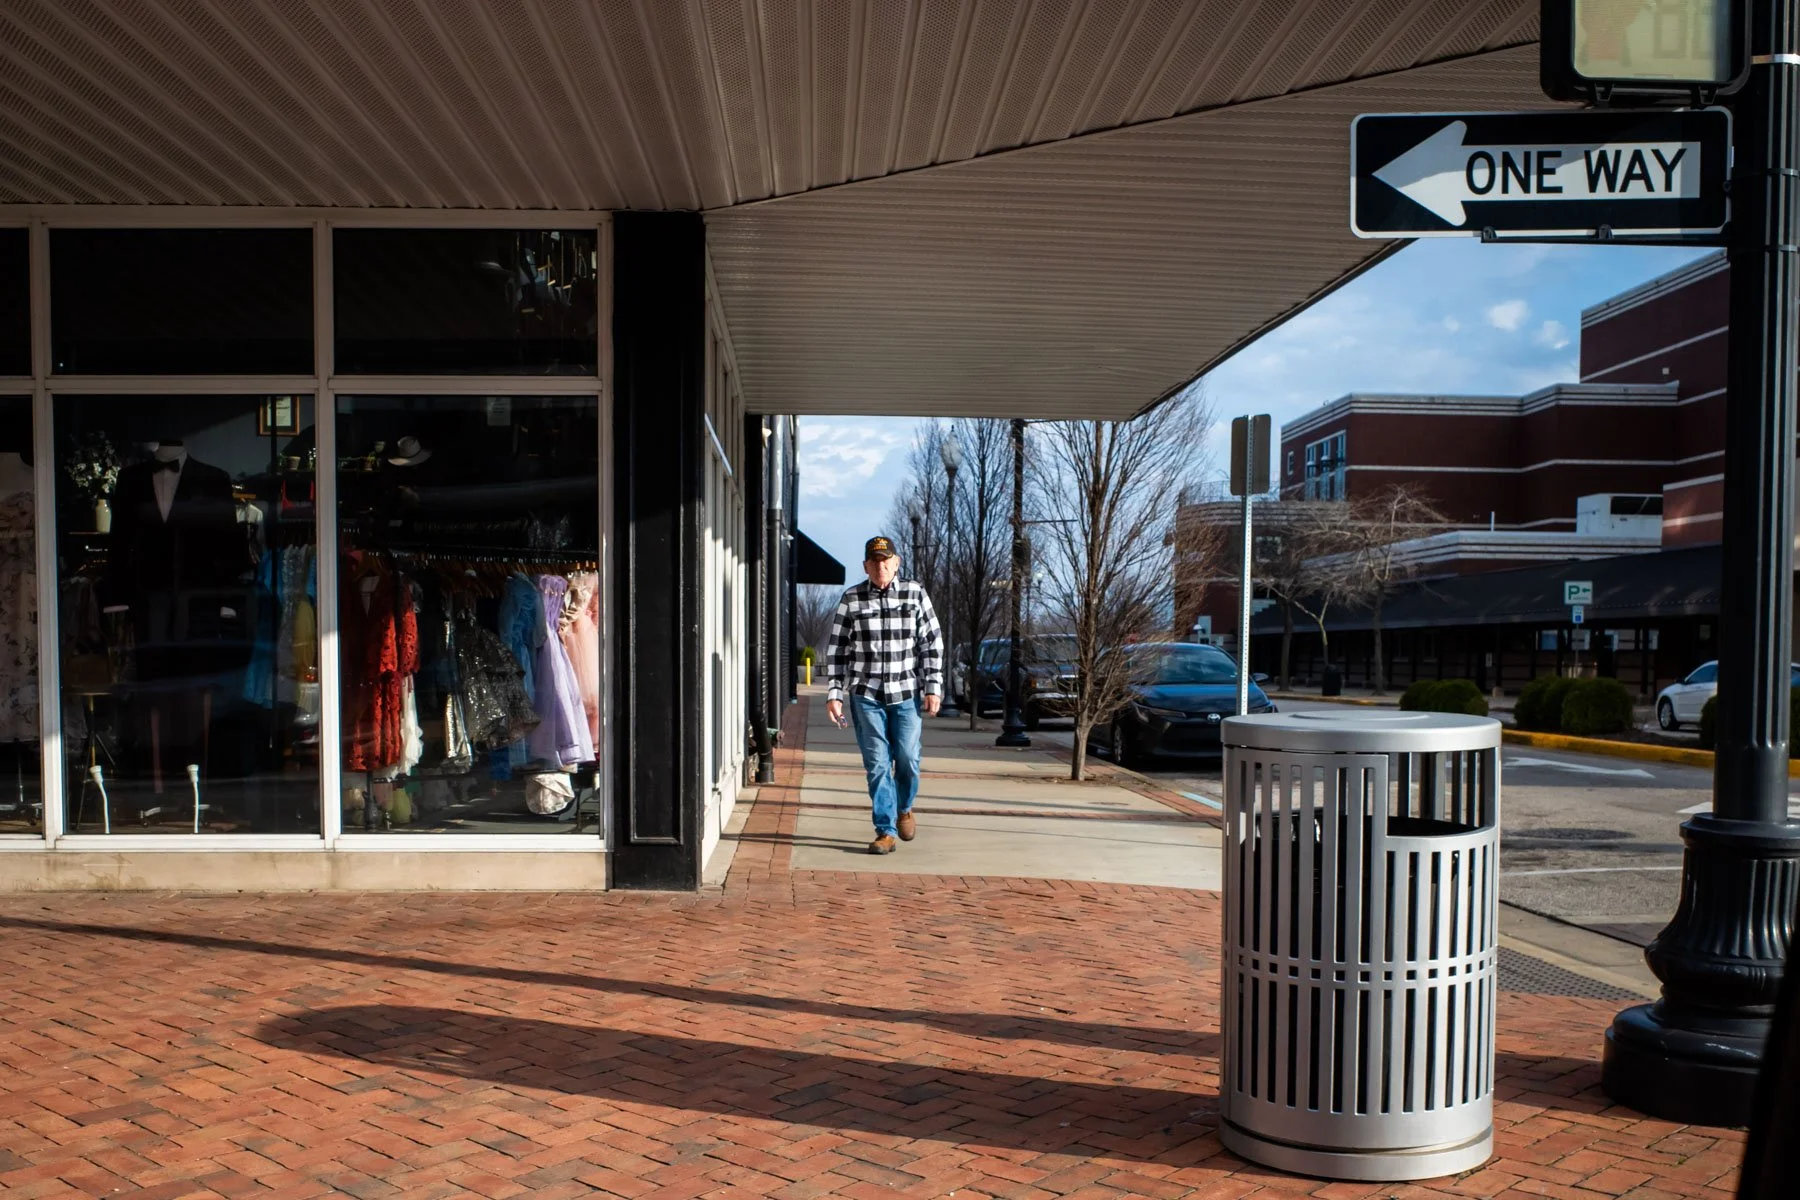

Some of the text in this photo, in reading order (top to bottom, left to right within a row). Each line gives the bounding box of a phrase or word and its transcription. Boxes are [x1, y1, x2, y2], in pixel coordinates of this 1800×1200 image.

[1465, 148, 1687, 196] ONE WAY
[1568, 585, 1580, 600] P
